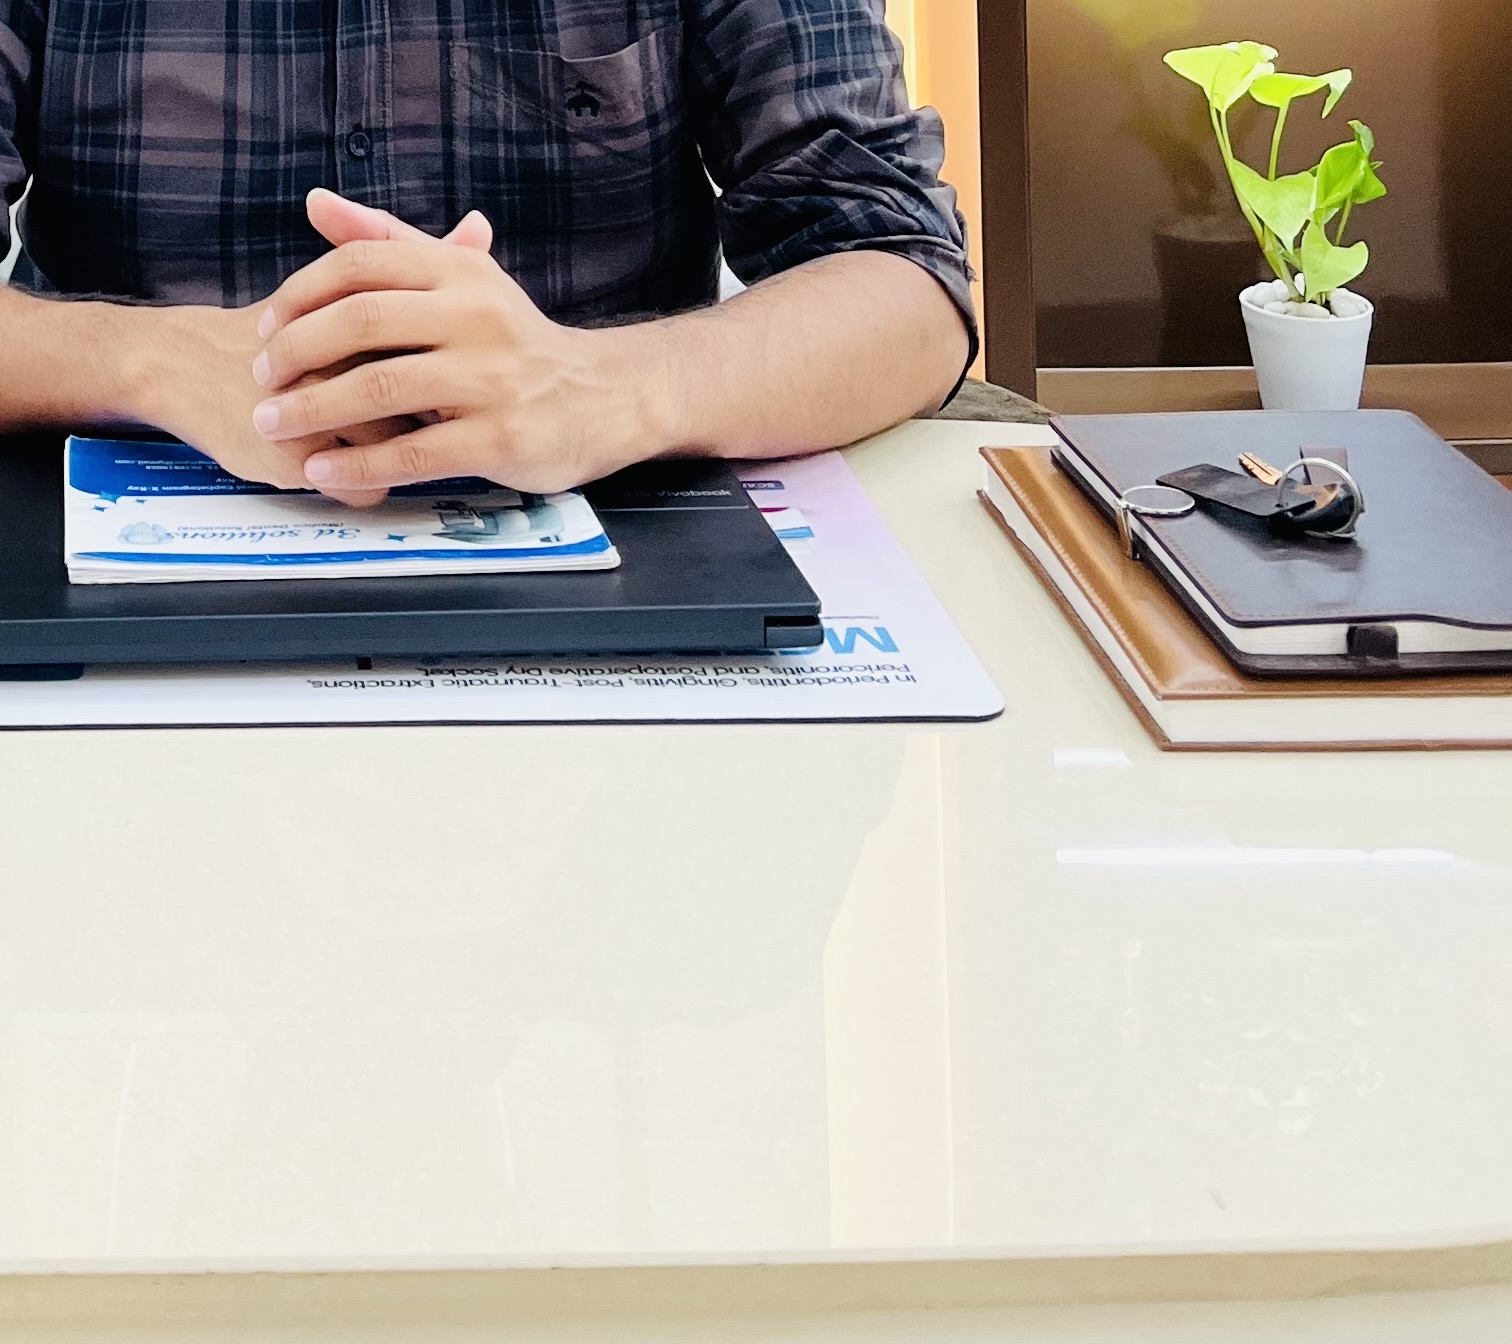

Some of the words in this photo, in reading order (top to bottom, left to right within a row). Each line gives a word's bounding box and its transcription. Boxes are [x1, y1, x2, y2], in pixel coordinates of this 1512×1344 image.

[163, 529, 300, 545] solutions
[503, 663, 543, 680] Dry
[547, 663, 708, 680] Postoperative
[712, 664, 758, 678] and
[305, 677, 435, 693] Extractions,
[441, 676, 624, 691] Post-Traumatic
[628, 674, 736, 690] Gingivitis,
[740, 674, 891, 690] Periodontitis,
[895, 673, 917, 686] In
